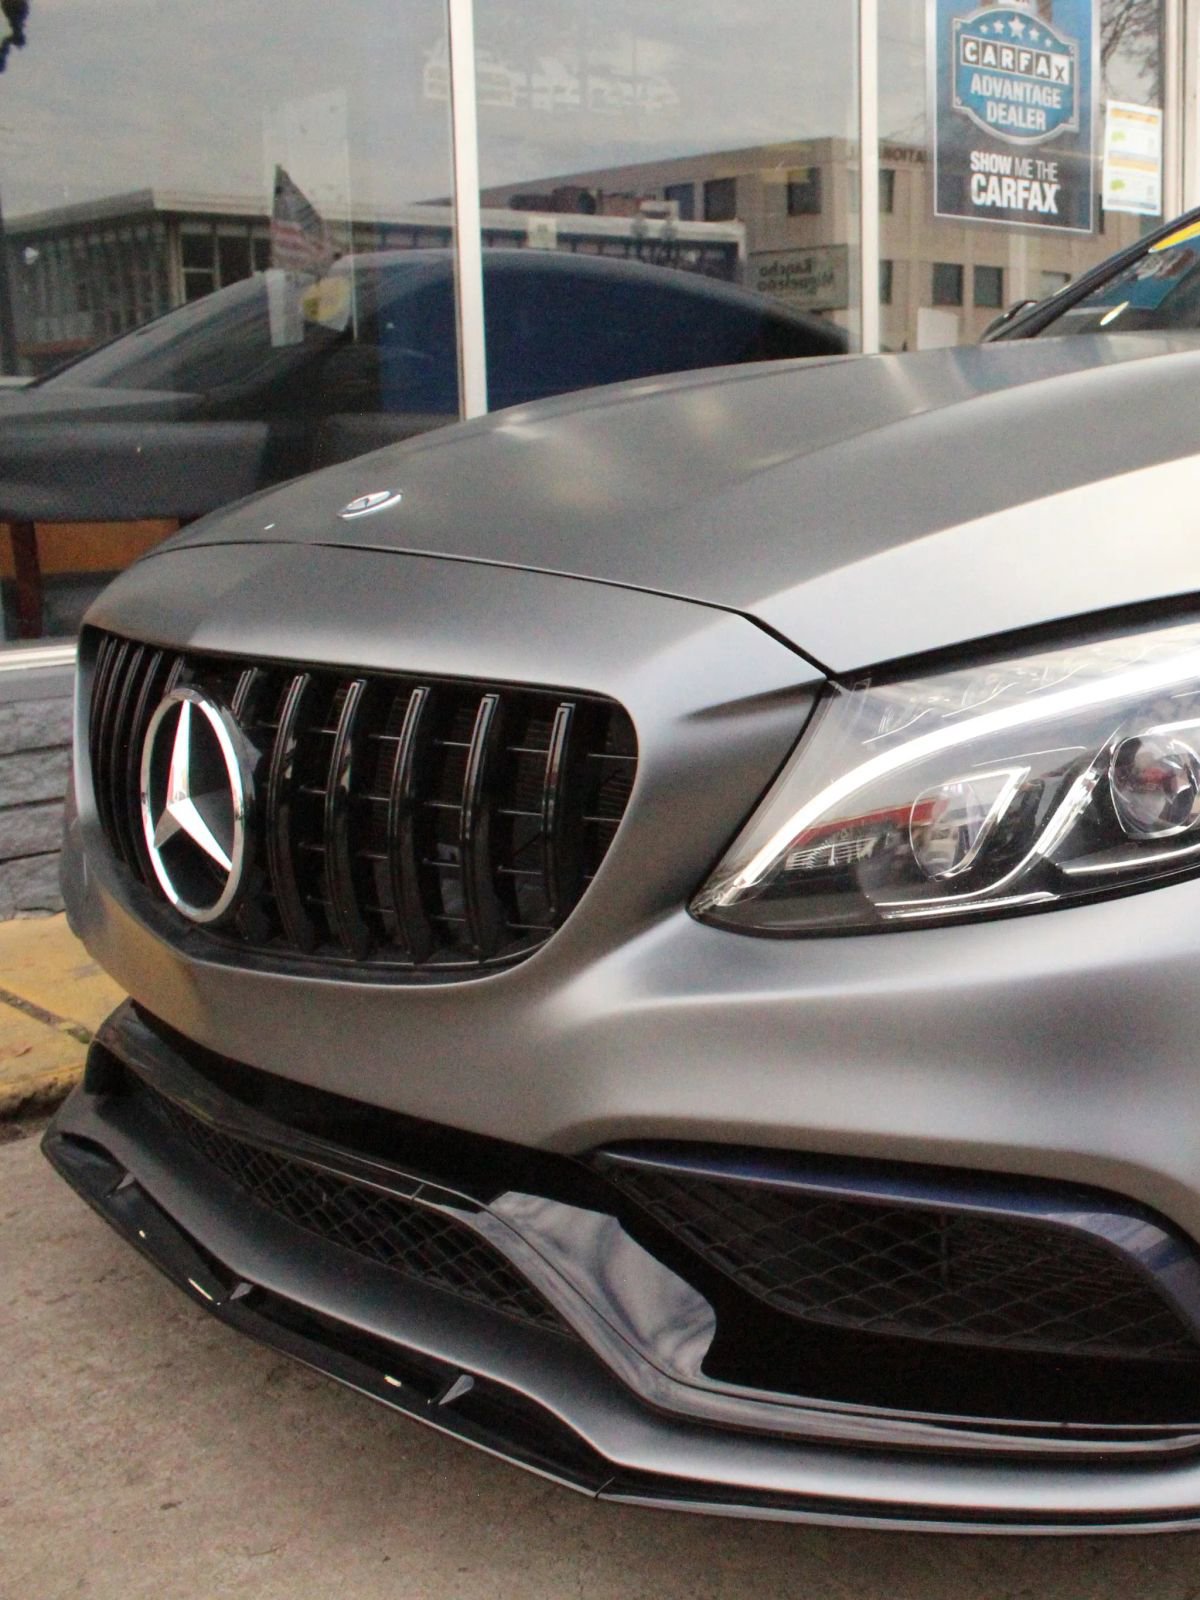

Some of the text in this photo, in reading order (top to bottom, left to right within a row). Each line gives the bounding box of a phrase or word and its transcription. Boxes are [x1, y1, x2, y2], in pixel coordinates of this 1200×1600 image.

[962, 39, 1067, 83] CARFAX
[970, 73, 1062, 109] ADVANTAGE
[986, 100, 1047, 131] DEALER
[970, 150, 1058, 182] SHOW ME THE
[970, 173, 1061, 214] CARFAX
